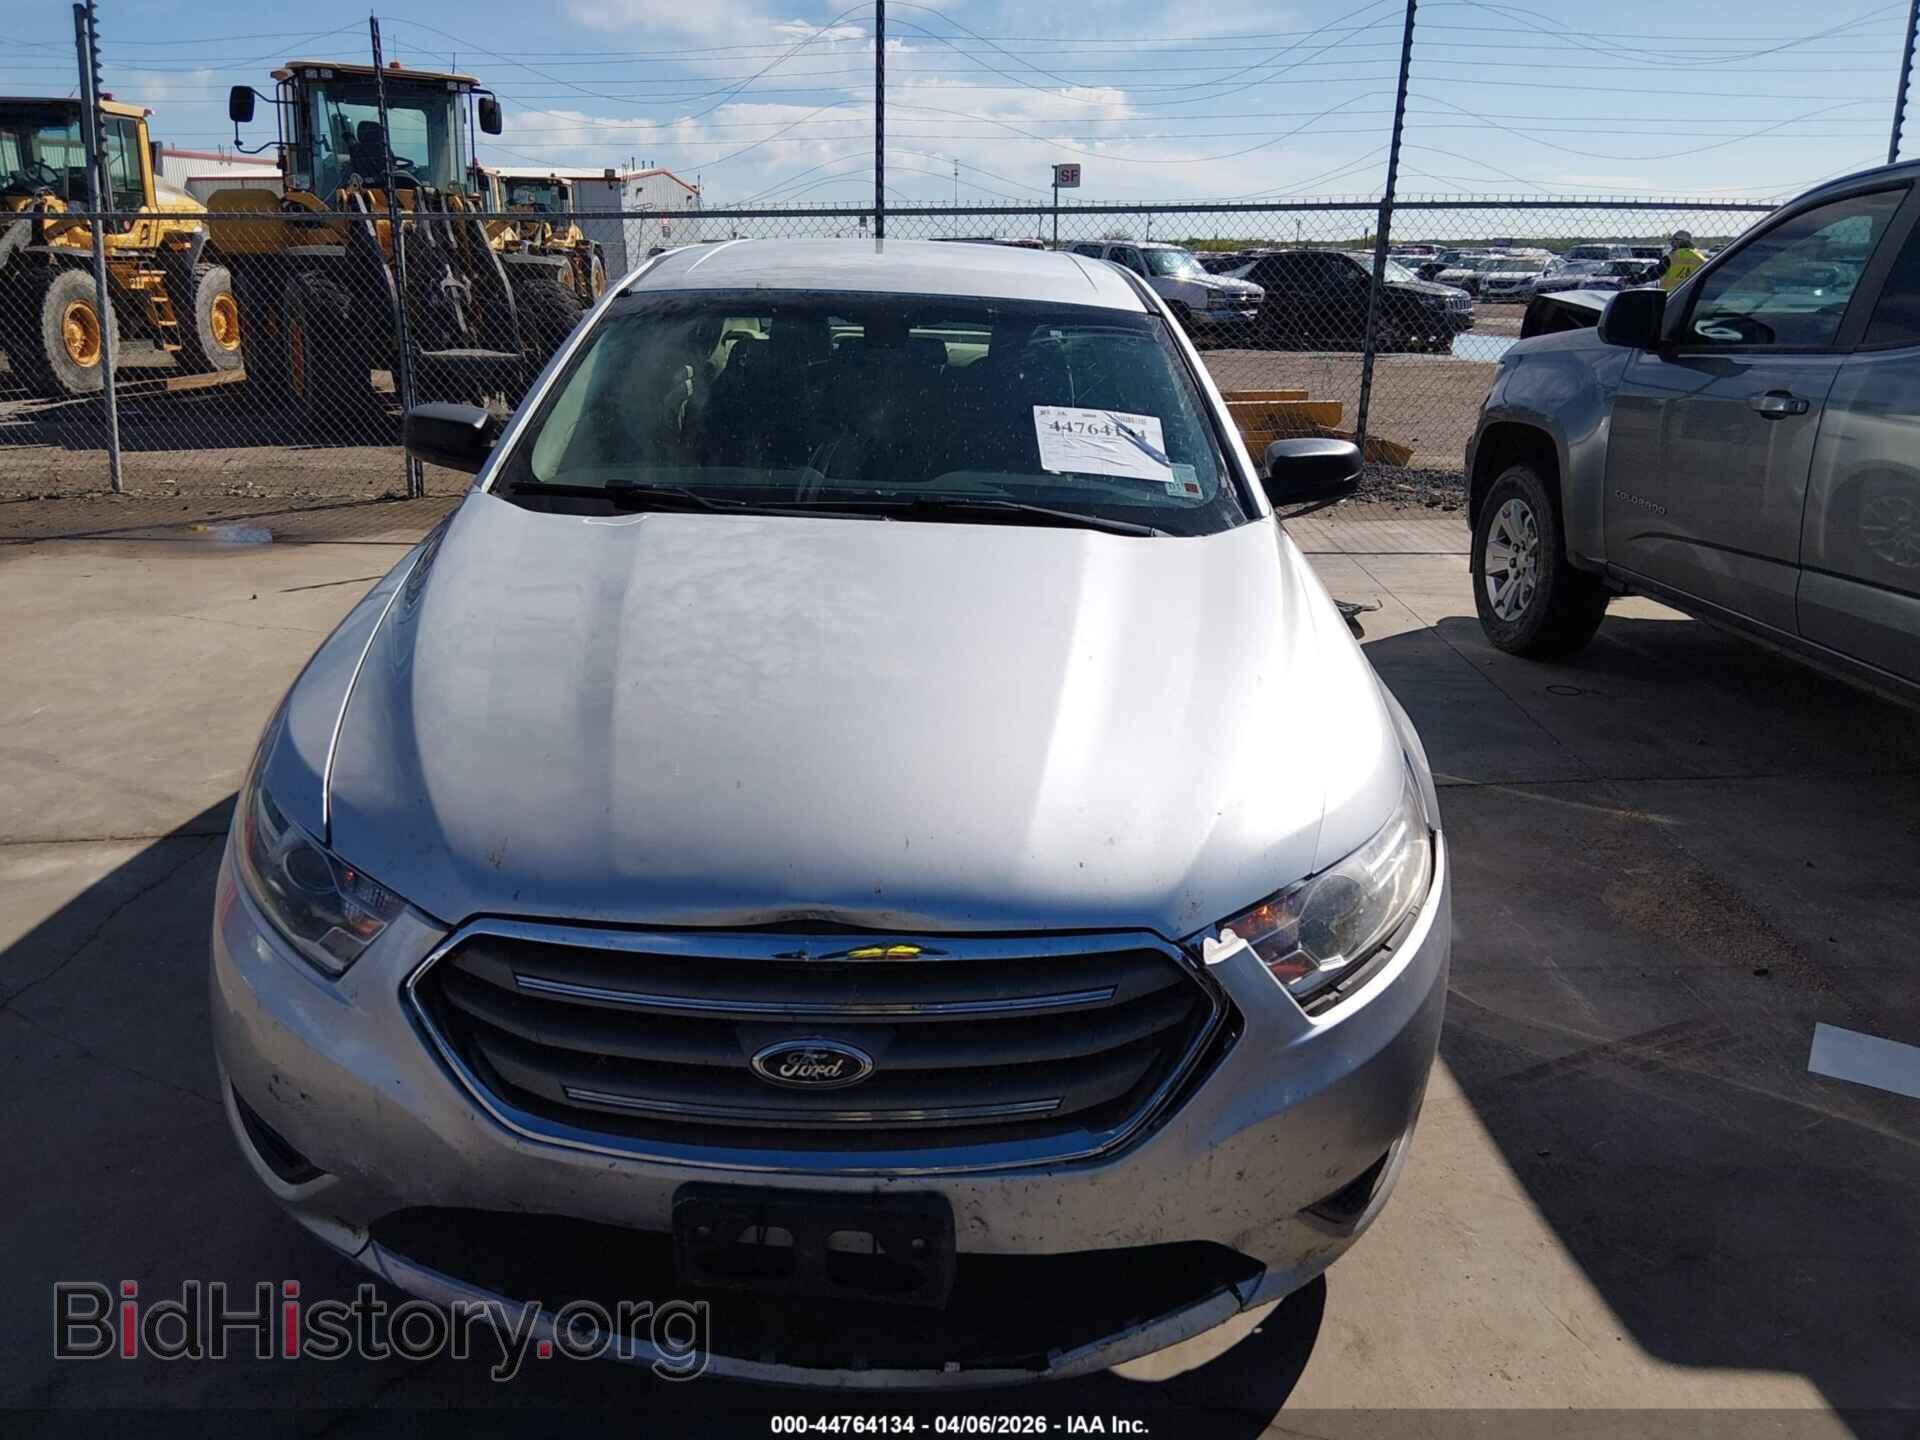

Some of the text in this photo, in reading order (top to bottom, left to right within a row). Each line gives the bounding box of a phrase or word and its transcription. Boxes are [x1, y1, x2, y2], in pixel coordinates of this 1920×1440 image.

[1061, 169, 1079, 182] SF
[1050, 420, 1147, 439] 4476414
[780, 1052, 843, 1080] Ford
